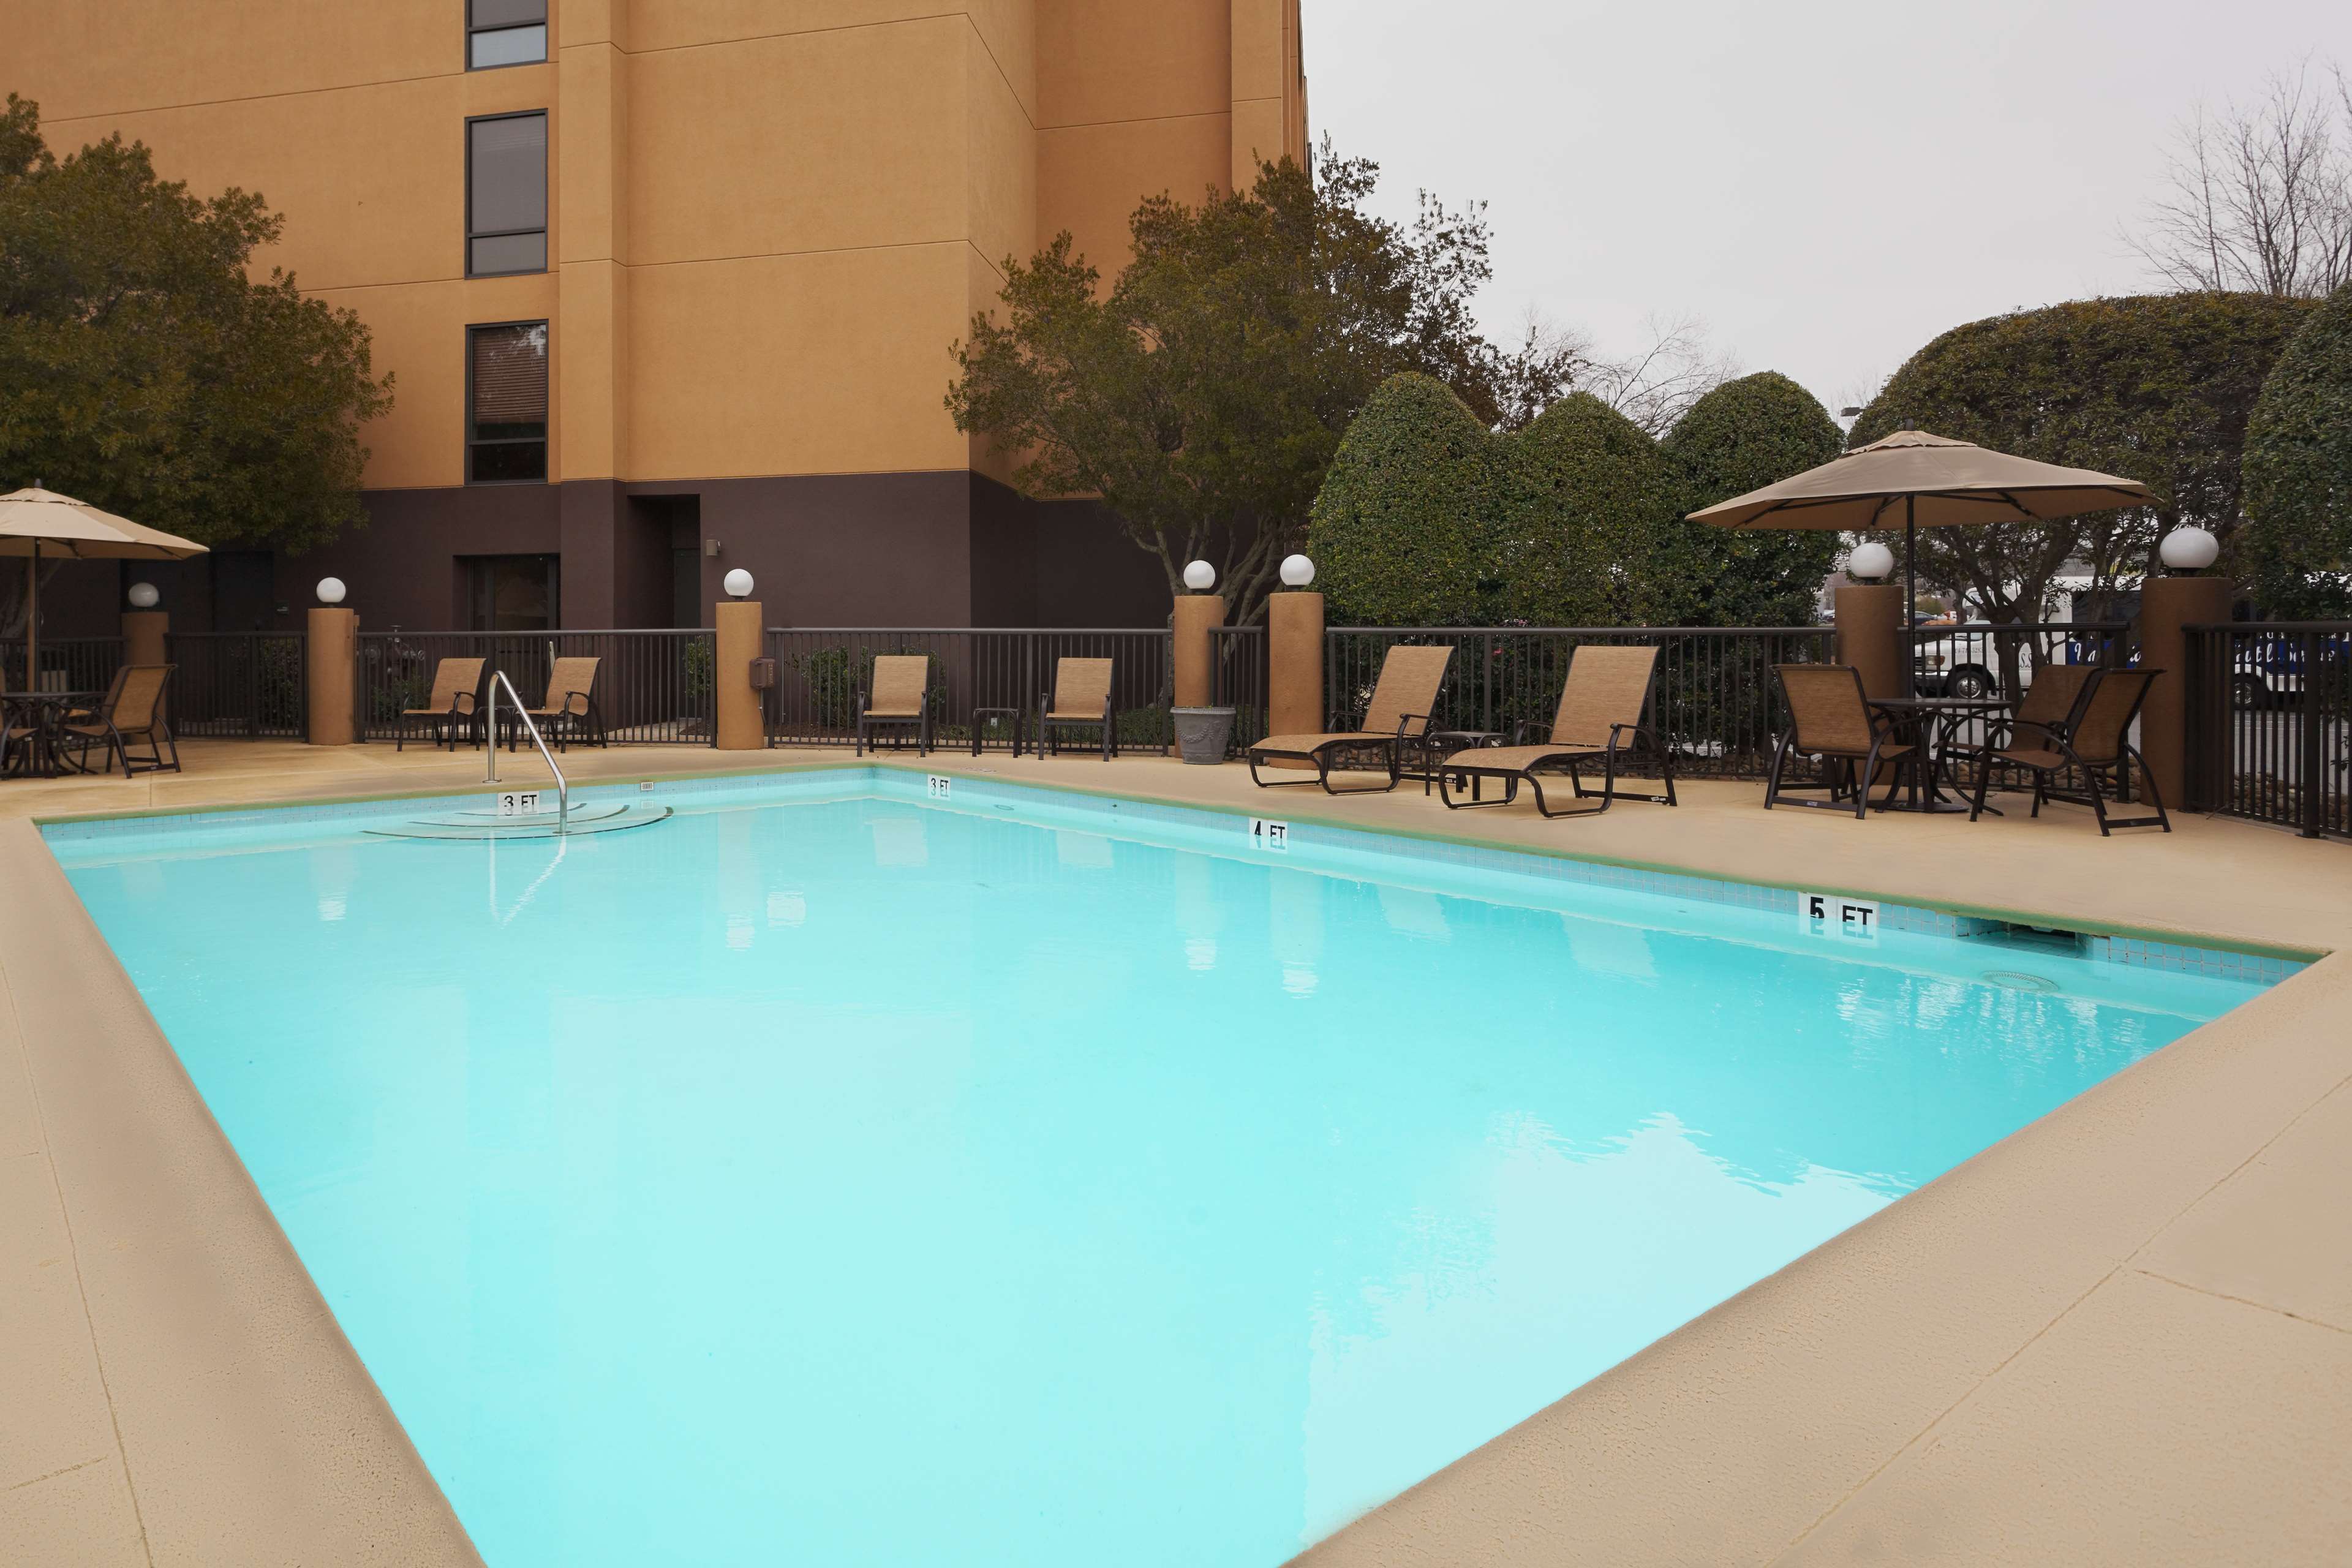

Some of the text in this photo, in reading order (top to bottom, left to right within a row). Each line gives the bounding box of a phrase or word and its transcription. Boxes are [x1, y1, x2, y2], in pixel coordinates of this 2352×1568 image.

[931, 778, 949, 790] 3 FT
[503, 794, 537, 807] 3 FT
[1254, 821, 1285, 839] 4 FT
[1809, 896, 1873, 925] 5 FT
